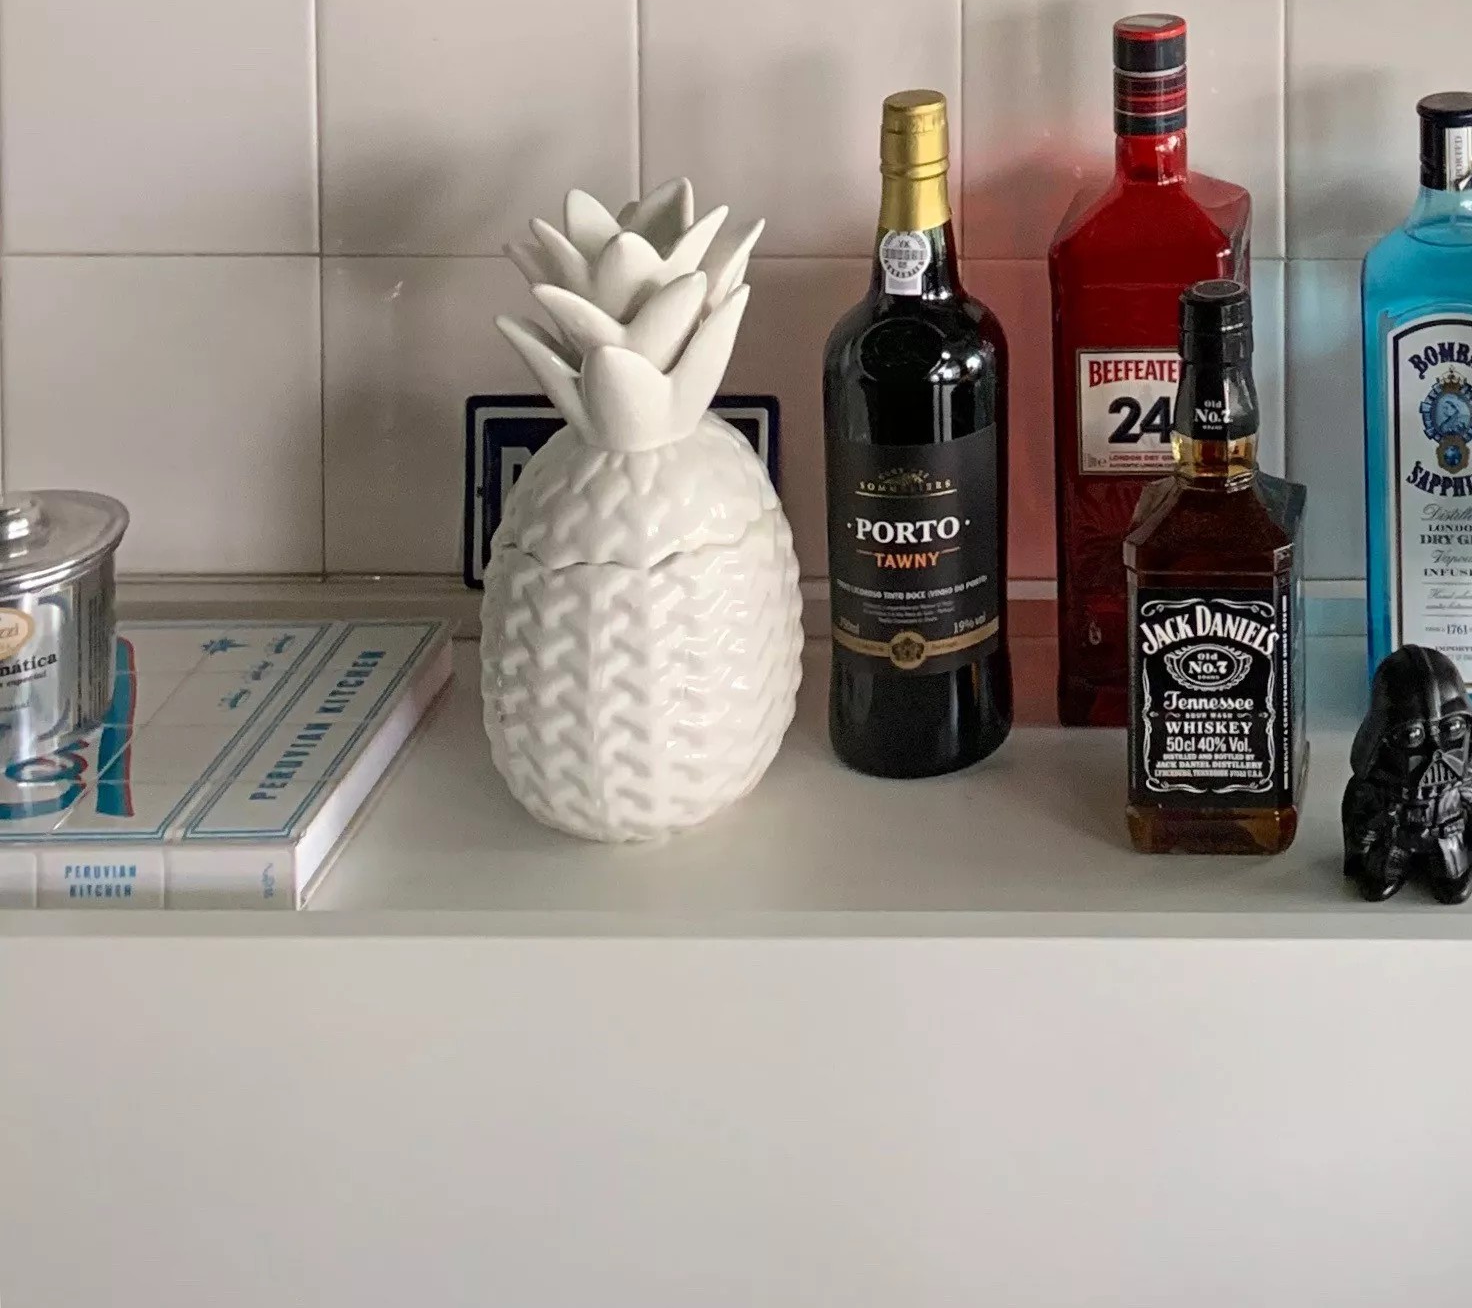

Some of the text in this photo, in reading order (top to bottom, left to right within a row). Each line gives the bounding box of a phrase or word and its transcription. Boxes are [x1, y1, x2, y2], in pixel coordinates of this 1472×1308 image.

[1204, 400, 1222, 409] Old
[1108, 396, 1175, 444] 24
[855, 516, 960, 544] PORTO
[1420, 534, 1454, 545] DRY
[875, 551, 940, 569] TAWNY
[1140, 605, 1280, 656] JACK DANIEL'S
[1447, 624, 1468, 635] 1761
[1197, 653, 1218, 661] Old
[1188, 661, 1228, 674] No.7
[1163, 690, 1254, 710] Tennessee
[249, 651, 386, 800] PERUVIAN KITCHEN
[1165, 721, 1253, 734] WHISKEY
[1166, 736, 1252, 752] 50cl 40% Vol.
[1156, 761, 1263, 769] JACK DANIEL DISTILLERY
[64, 865, 136, 880] PERUVIAN
[69, 884, 132, 898] KITCHEN
